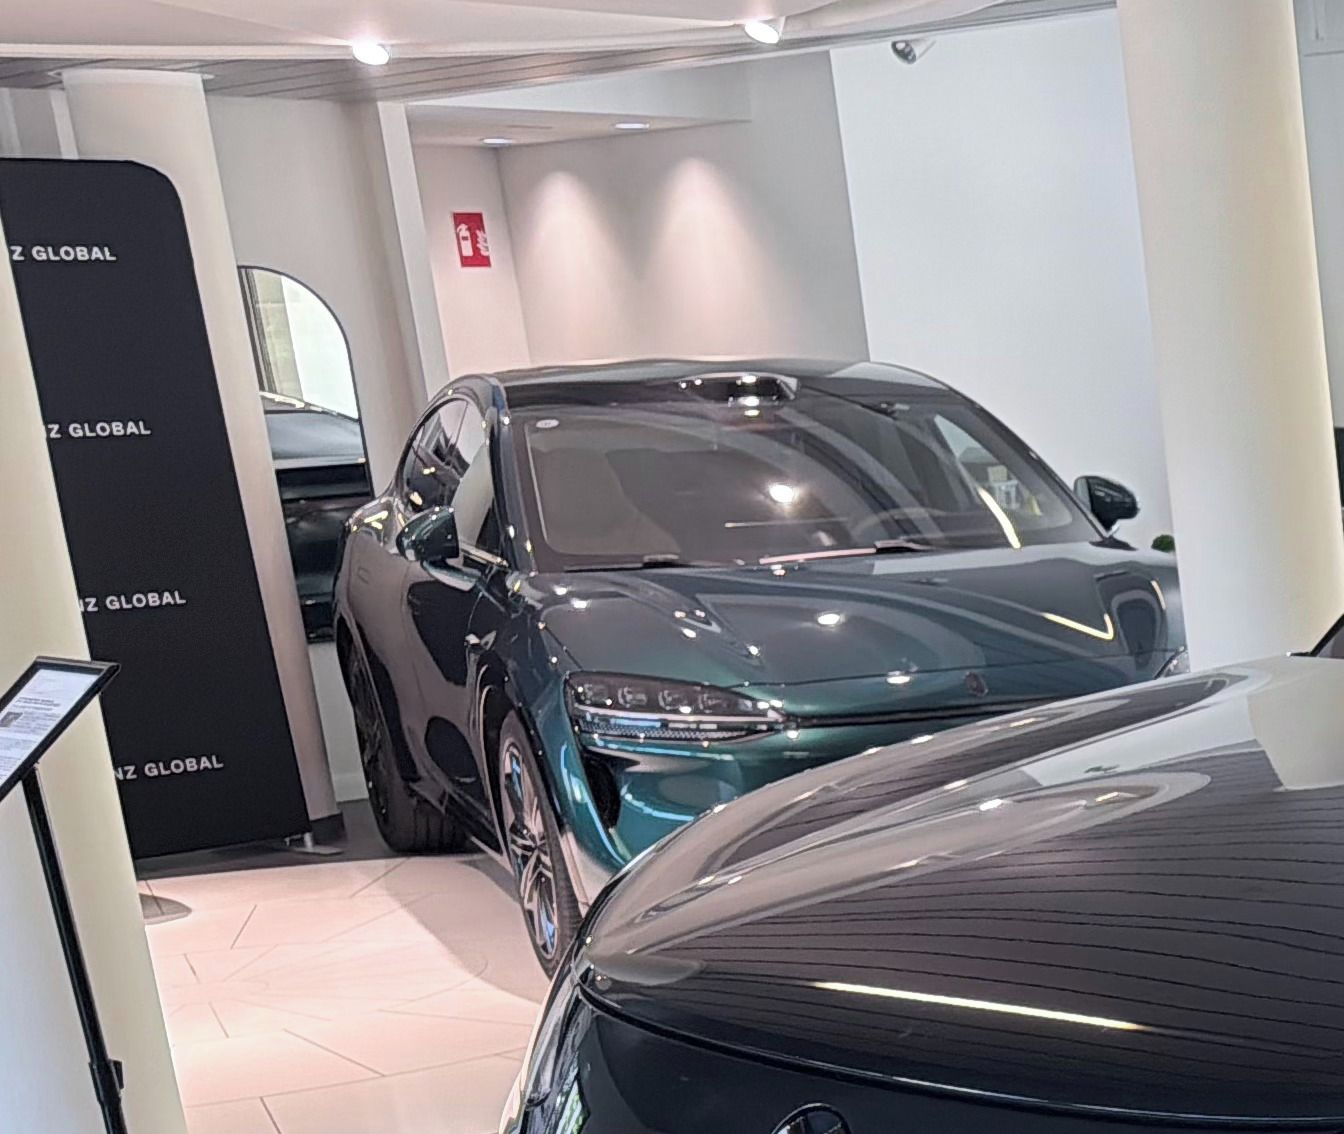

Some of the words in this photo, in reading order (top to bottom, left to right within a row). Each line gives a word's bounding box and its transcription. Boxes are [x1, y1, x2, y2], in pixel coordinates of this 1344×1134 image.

[31, 245, 117, 261] GLOBAL
[68, 421, 151, 438] GLOBAL
[105, 590, 187, 610] GLOBAL
[144, 755, 224, 777] GLOBAL
